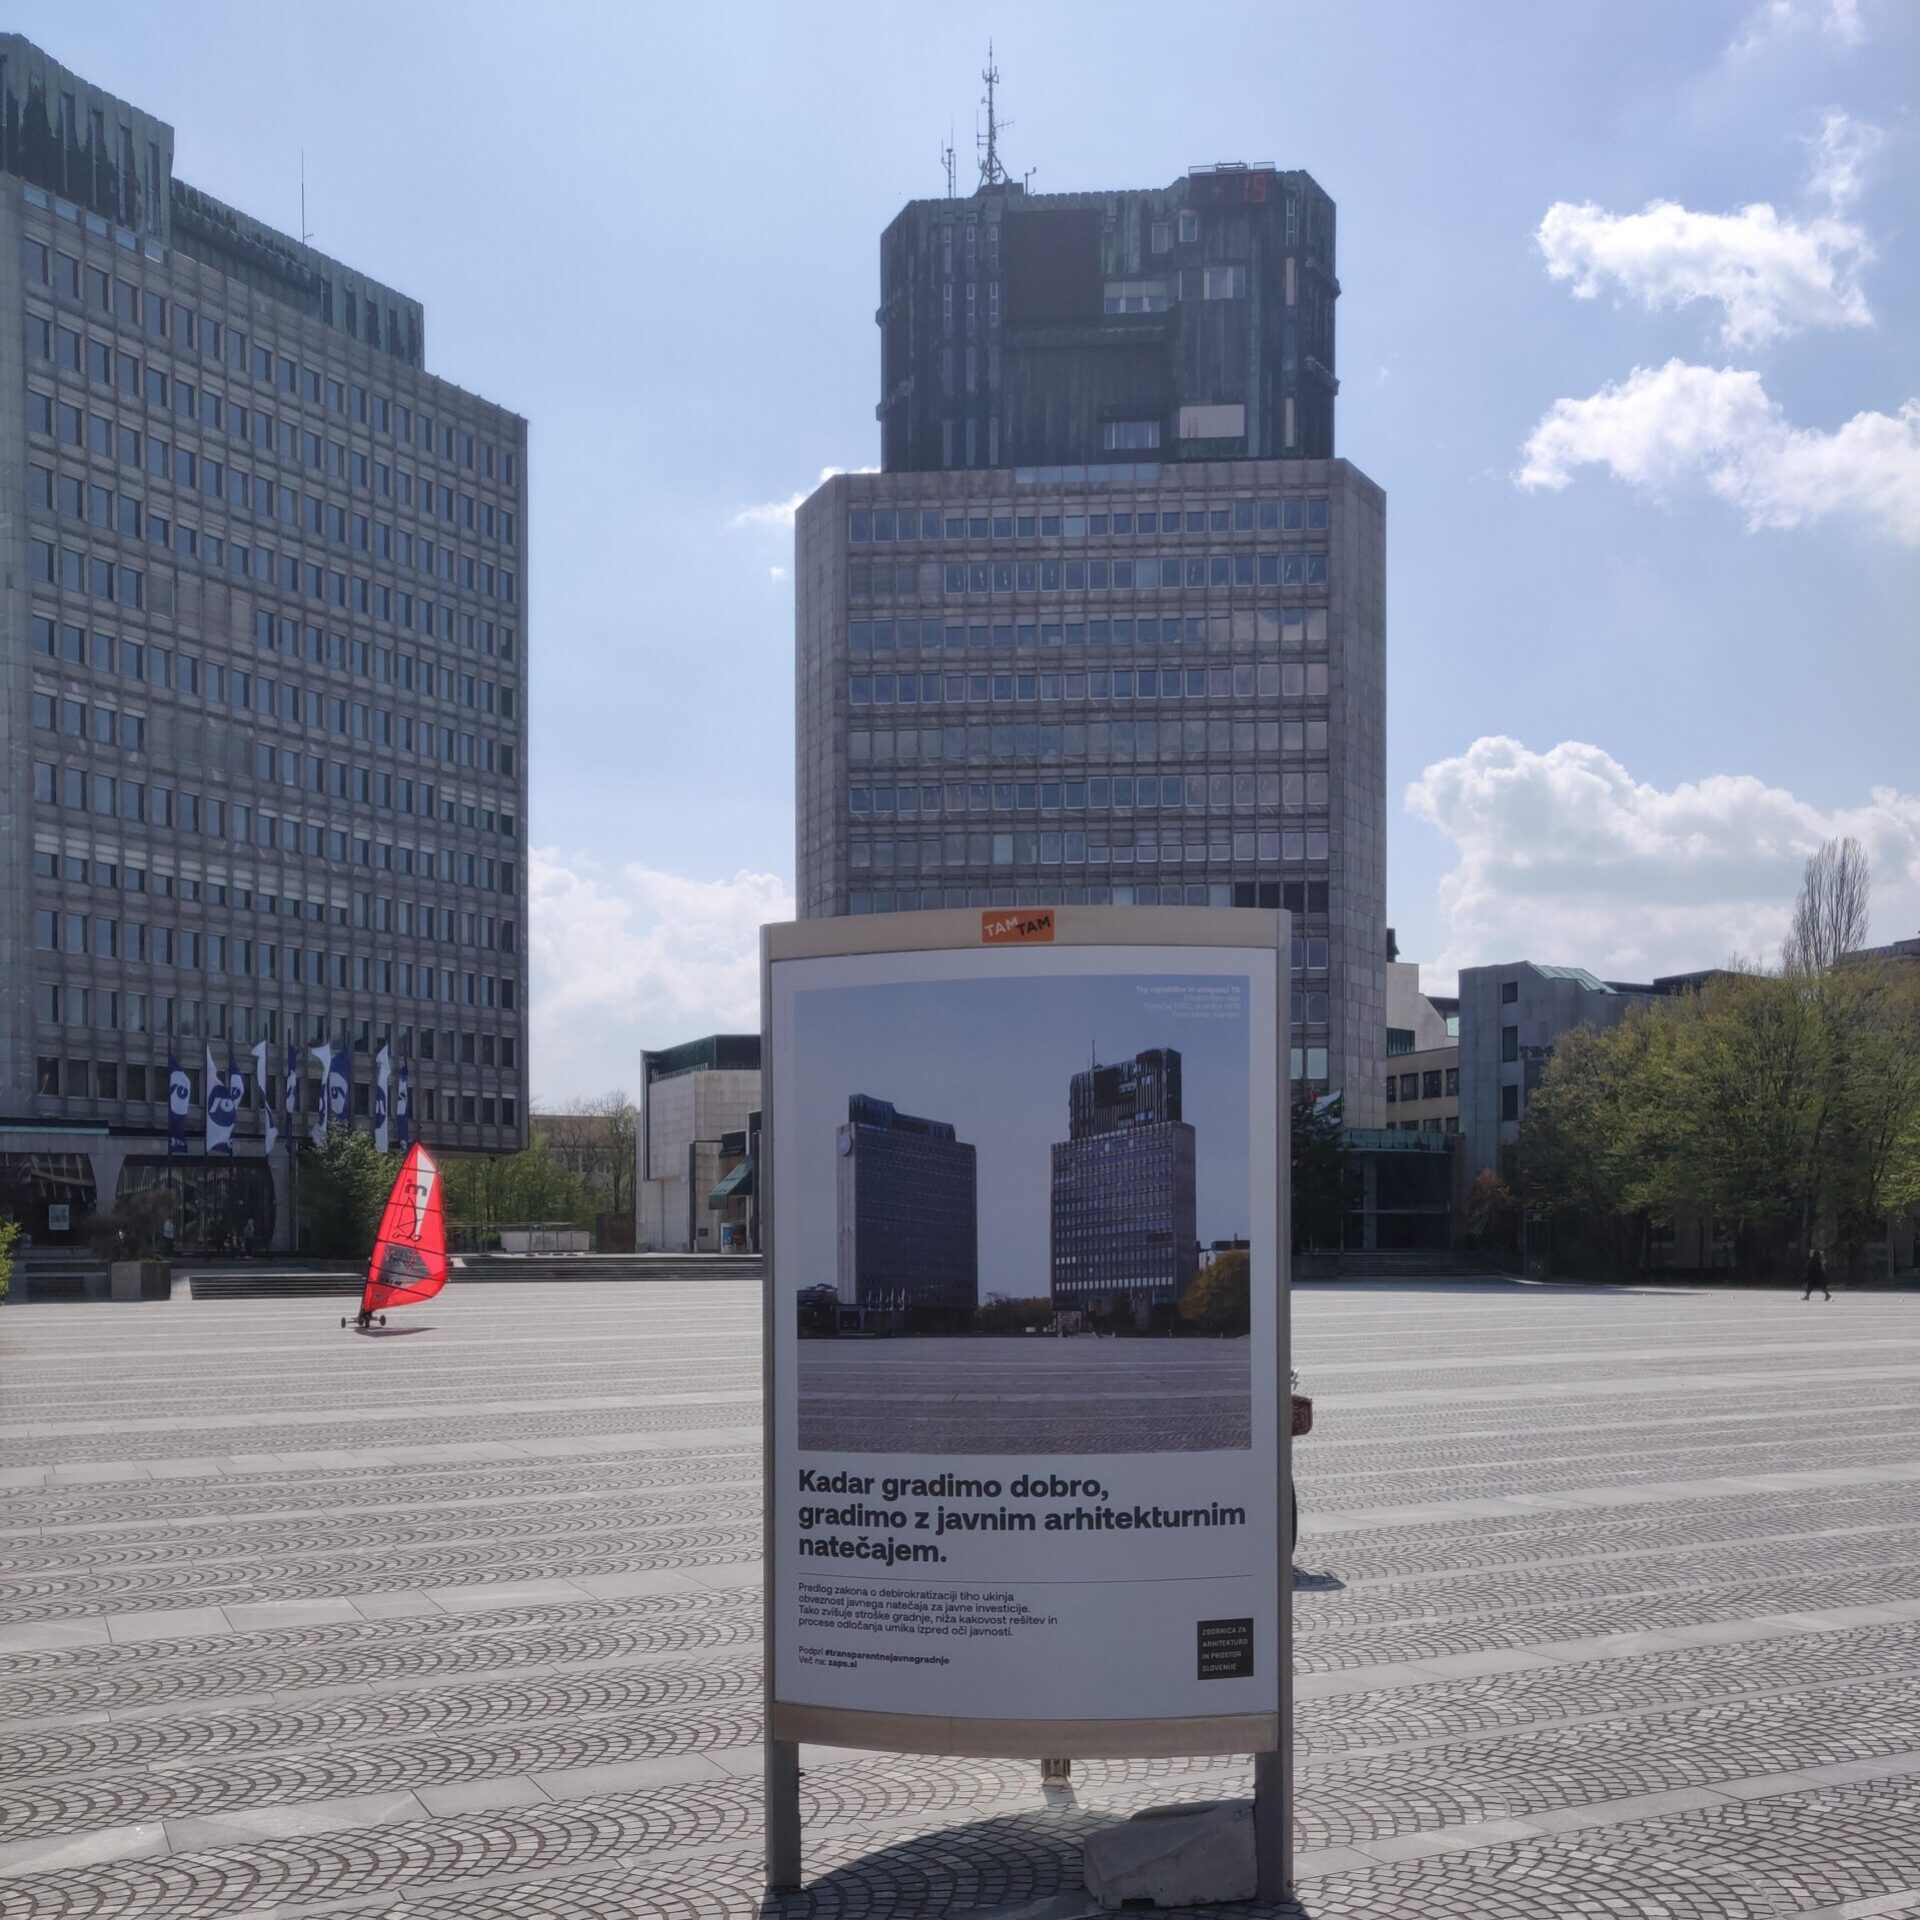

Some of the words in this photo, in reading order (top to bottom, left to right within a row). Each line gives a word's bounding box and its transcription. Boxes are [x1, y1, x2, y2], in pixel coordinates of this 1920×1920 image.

[984, 916, 1019, 937] TAM
[1016, 916, 1051, 936] TAM
[799, 1469, 875, 1495] Kadar
[882, 1473, 1002, 1502] gradimo
[1010, 1474, 1109, 1501] dobro,
[799, 1503, 907, 1530] gradimo
[914, 1511, 930, 1529] z
[935, 1506, 1036, 1536] javnim
[1044, 1501, 1246, 1531] arhitekturnim
[799, 1535, 947, 1567] natečajem.
[798, 1582, 833, 1596] Predlog
[834, 1585, 868, 1597] zakona
[870, 1589, 877, 1597] o
[879, 1588, 957, 1602] debirokratizaciji
[960, 1591, 980, 1601] tiho
[982, 1591, 1014, 1603] ukinja
[798, 1594, 845, 1606] obveznost
[845, 1597, 884, 1610] javnega
[886, 1601, 928, 1612] natečaja
[931, 1603, 943, 1611] za
[944, 1602, 973, 1613] javne
[975, 1602, 1030, 1615] investicije.
[798, 1604, 819, 1615] Tako
[821, 1607, 853, 1620] zvišuje
[854, 1610, 890, 1621] stroške
[892, 1612, 933, 1624] gradnje,
[935, 1614, 957, 1624] niža
[959, 1614, 1007, 1625] kakovost
[1009, 1615, 1045, 1625] rešitev
[1048, 1615, 1058, 1625] in
[798, 1617, 835, 1628] procese
[836, 1619, 883, 1633] odločanja
[885, 1624, 915, 1634] umika
[917, 1625, 949, 1636] izpred
[951, 1626, 967, 1635] oči
[968, 1626, 1014, 1638] javnosti.
[1201, 1627, 1237, 1636] ZBORNICA
[1237, 1626, 1247, 1634] ZA
[798, 1645, 823, 1656] Podpri
[825, 1648, 950, 1666] #transparentnejavnegradnje
[1201, 1652, 1210, 1660] IN
[1210, 1650, 1242, 1660] PROSTOR
